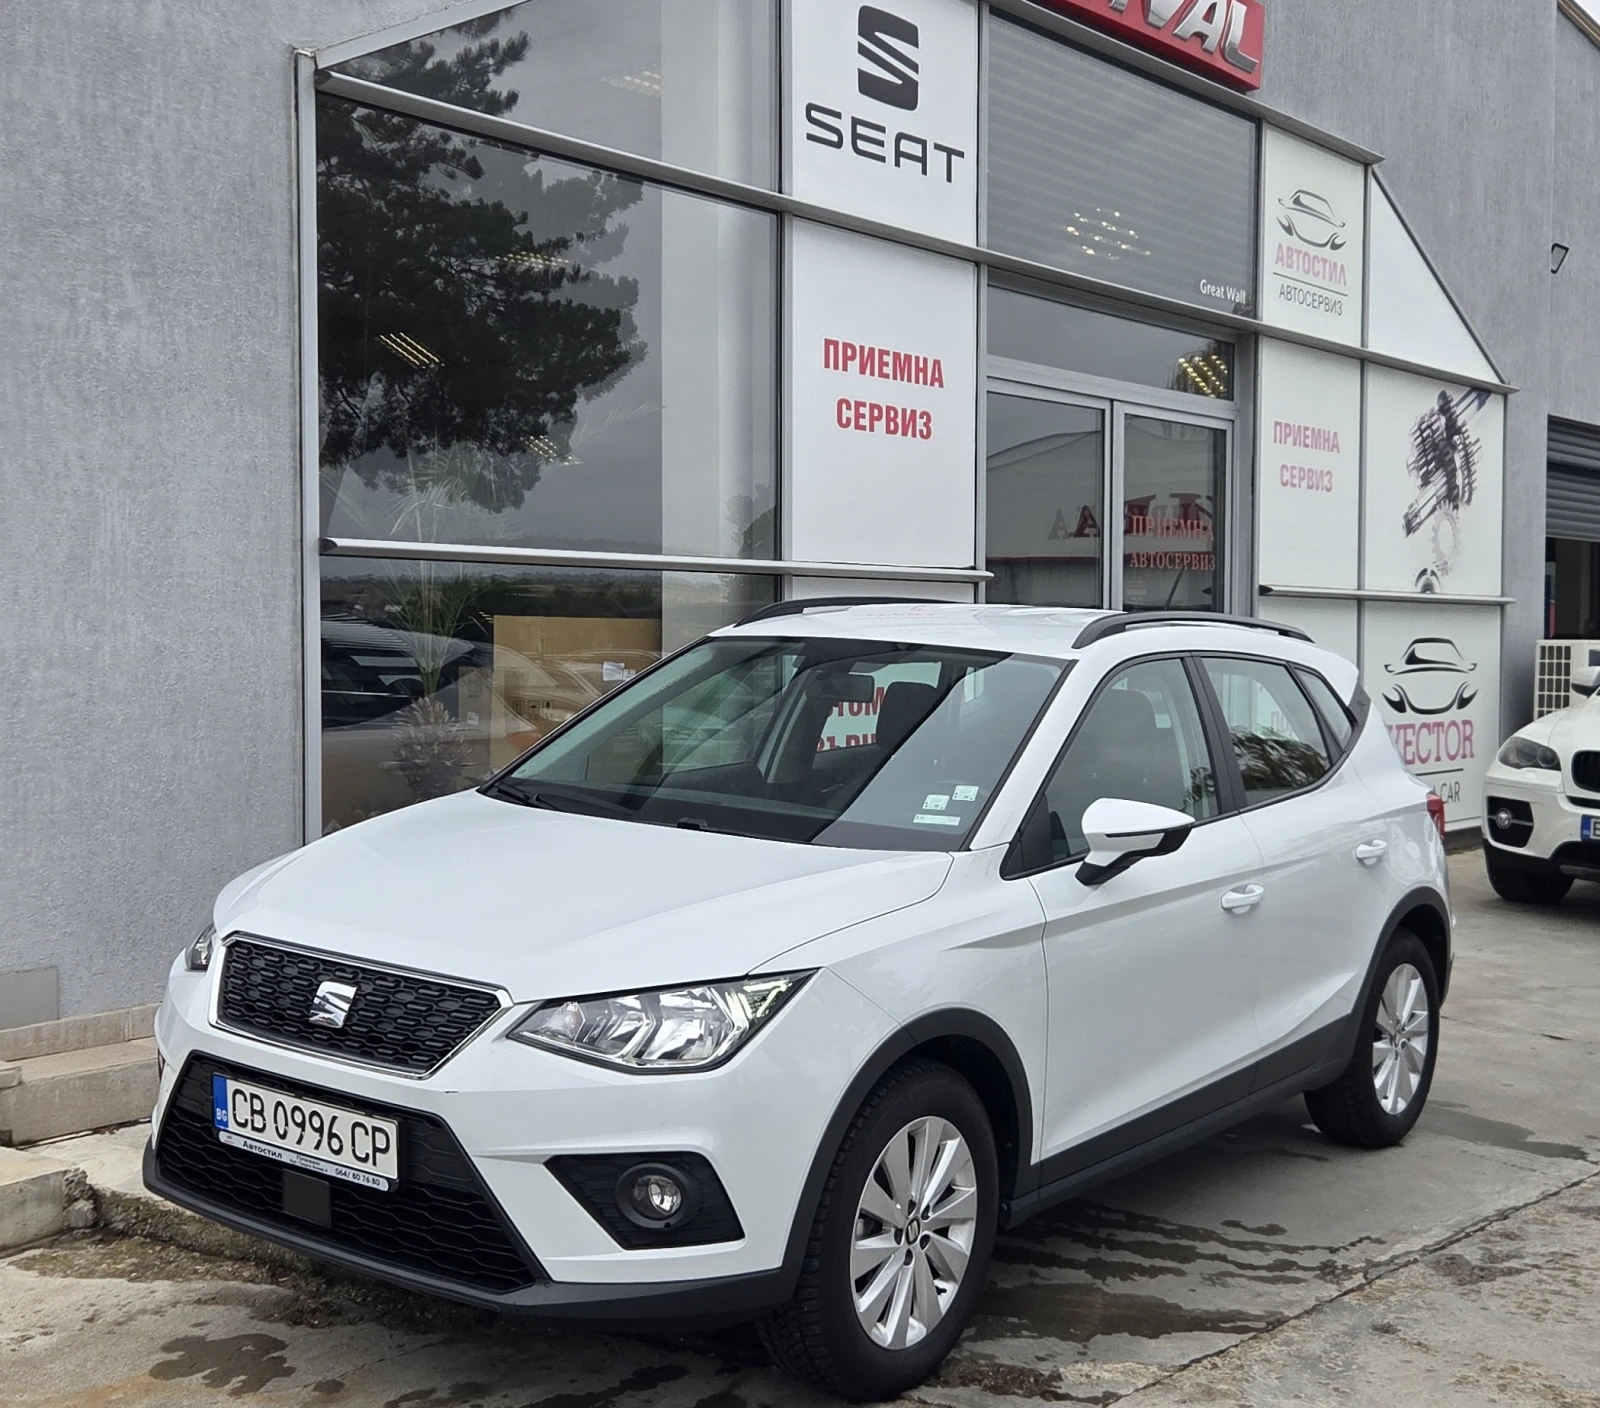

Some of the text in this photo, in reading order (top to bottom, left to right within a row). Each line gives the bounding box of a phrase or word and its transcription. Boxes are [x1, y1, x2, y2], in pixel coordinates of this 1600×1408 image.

[1108, 0, 1260, 74] VAL
[805, 102, 965, 183] SEAT
[1275, 243, 1347, 287] АВТОСТИЛ
[1200, 279, 1246, 304] Great Wall
[1279, 284, 1343, 316] АВТОСЕРВИЗ
[824, 338, 944, 389] ПРИЕМНА
[836, 398, 932, 440] СЕРВИЗ
[1273, 420, 1340, 454] ПРИЕМНА
[1280, 464, 1333, 493] СЕРВИЗ
[1132, 515, 1215, 541] ПРИЕМНА
[1130, 552, 1216, 571] АВТОСЕРВИЗ
[216, 1107, 228, 1122] BG
[232, 1089, 390, 1167] CB 0996 CP
